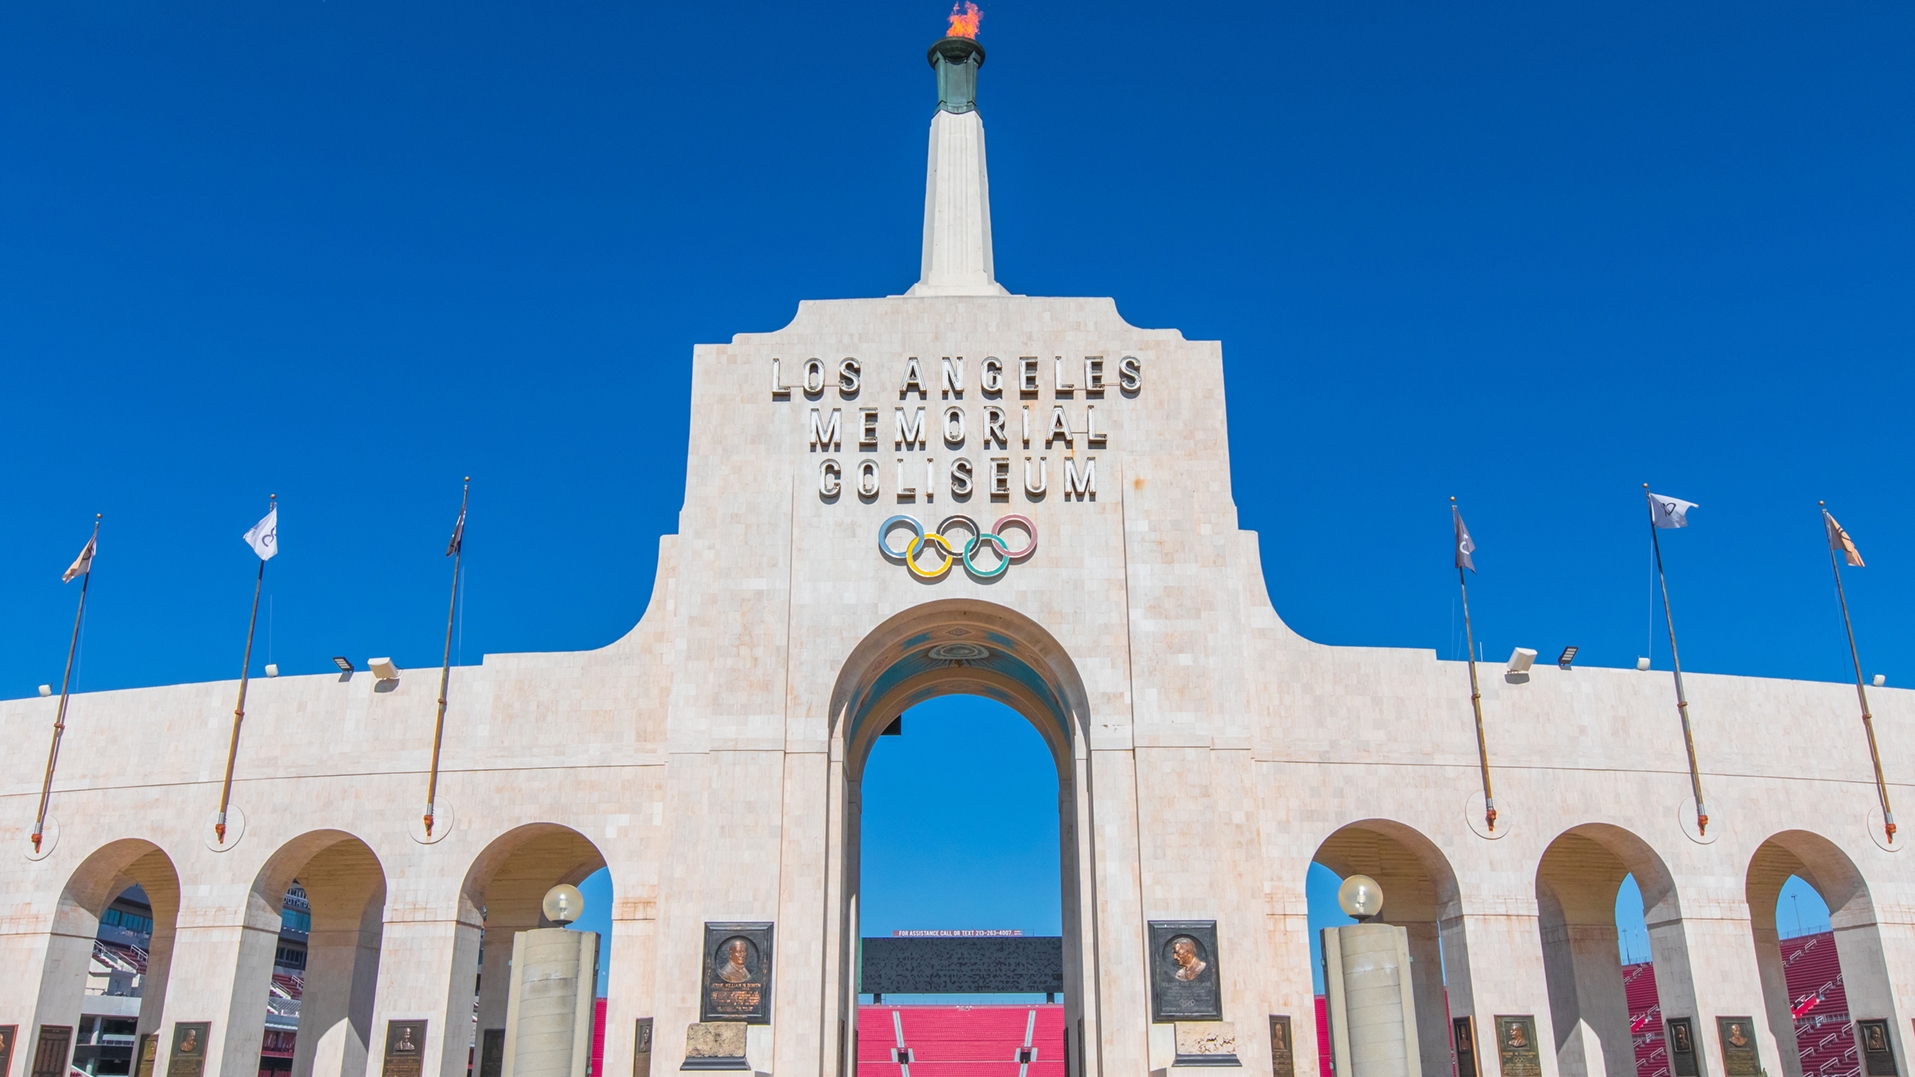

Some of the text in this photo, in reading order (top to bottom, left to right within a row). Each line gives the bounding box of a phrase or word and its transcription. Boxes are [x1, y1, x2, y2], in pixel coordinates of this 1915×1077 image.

[772, 355, 1141, 396] LOS ANGELES
[810, 405, 1107, 445] MEMORIAL
[819, 456, 1097, 498] COLISEUM
